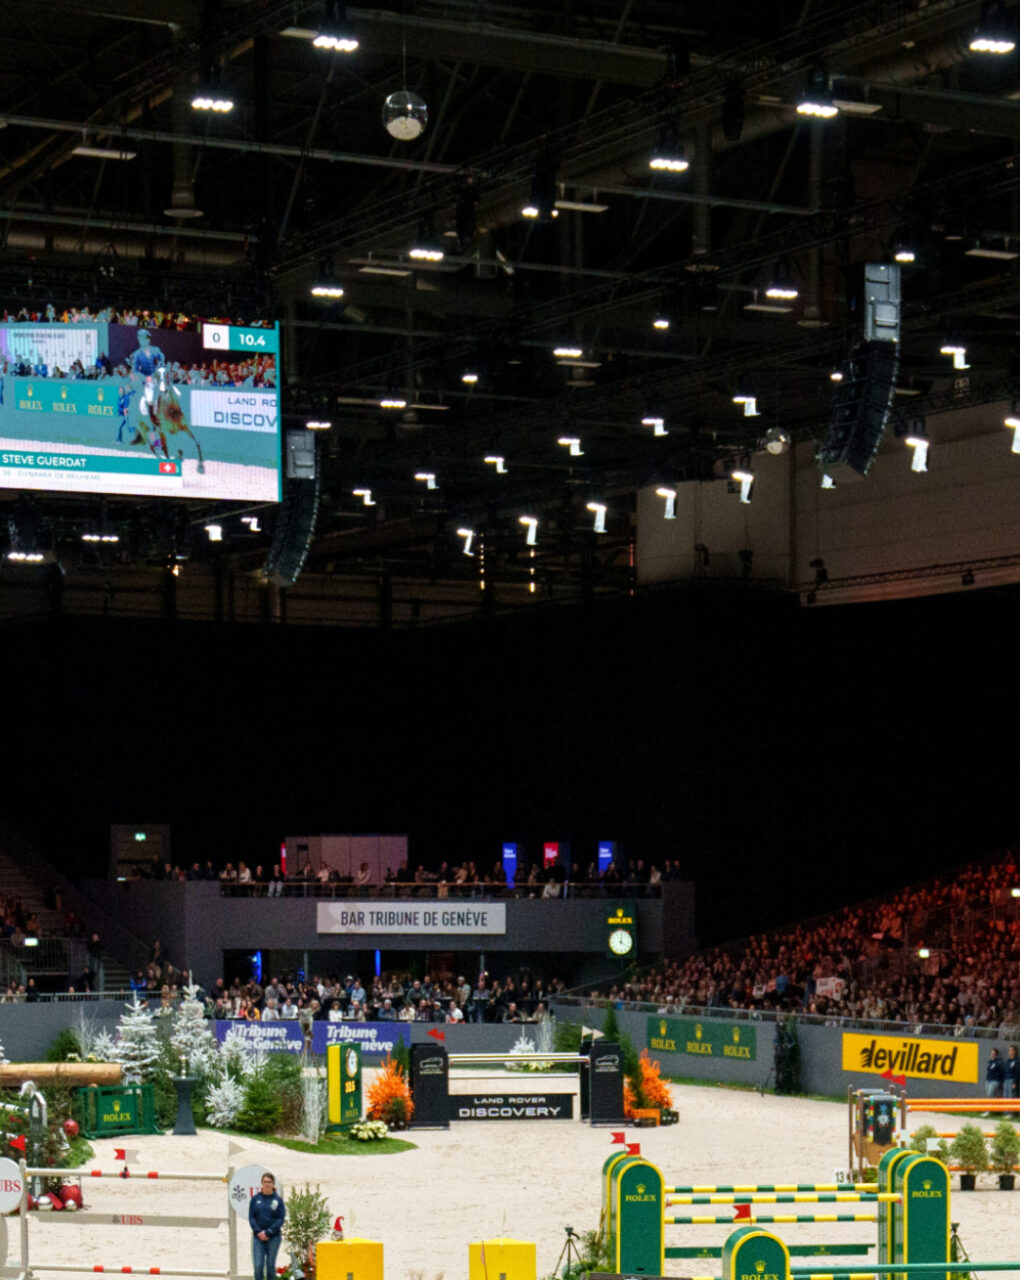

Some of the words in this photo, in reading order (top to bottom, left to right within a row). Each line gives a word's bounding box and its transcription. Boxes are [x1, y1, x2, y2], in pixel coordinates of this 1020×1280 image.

[212, 332, 221, 343] 0
[239, 334, 266, 346] 10.4
[228, 397, 256, 406] LAND
[214, 411, 277, 427] DISCOV
[2, 454, 34, 465] STEVE
[37, 456, 87, 468] GUERDAT
[341, 911, 365, 926] BAR
[369, 911, 419, 926] TRIBUNE
[424, 911, 438, 926] DE
[442, 907, 488, 926] GENÈVE
[235, 1024, 288, 1038] Tribune
[327, 1025, 377, 1039] Tribune
[651, 1038, 676, 1050] ROLEX
[686, 1041, 712, 1055] ROLEX
[723, 1044, 750, 1058] ROLEX
[860, 1039, 959, 1076] devillard
[474, 1097, 504, 1105] LAND
[103, 1112, 132, 1123] ROLEX
[459, 1107, 561, 1118] DISCOVERY
[835, 1171, 845, 1183] 13
[625, 1194, 657, 1203] ROLEX
[912, 1190, 943, 1199] ROLEX
[121, 1215, 143, 1226] UBS
